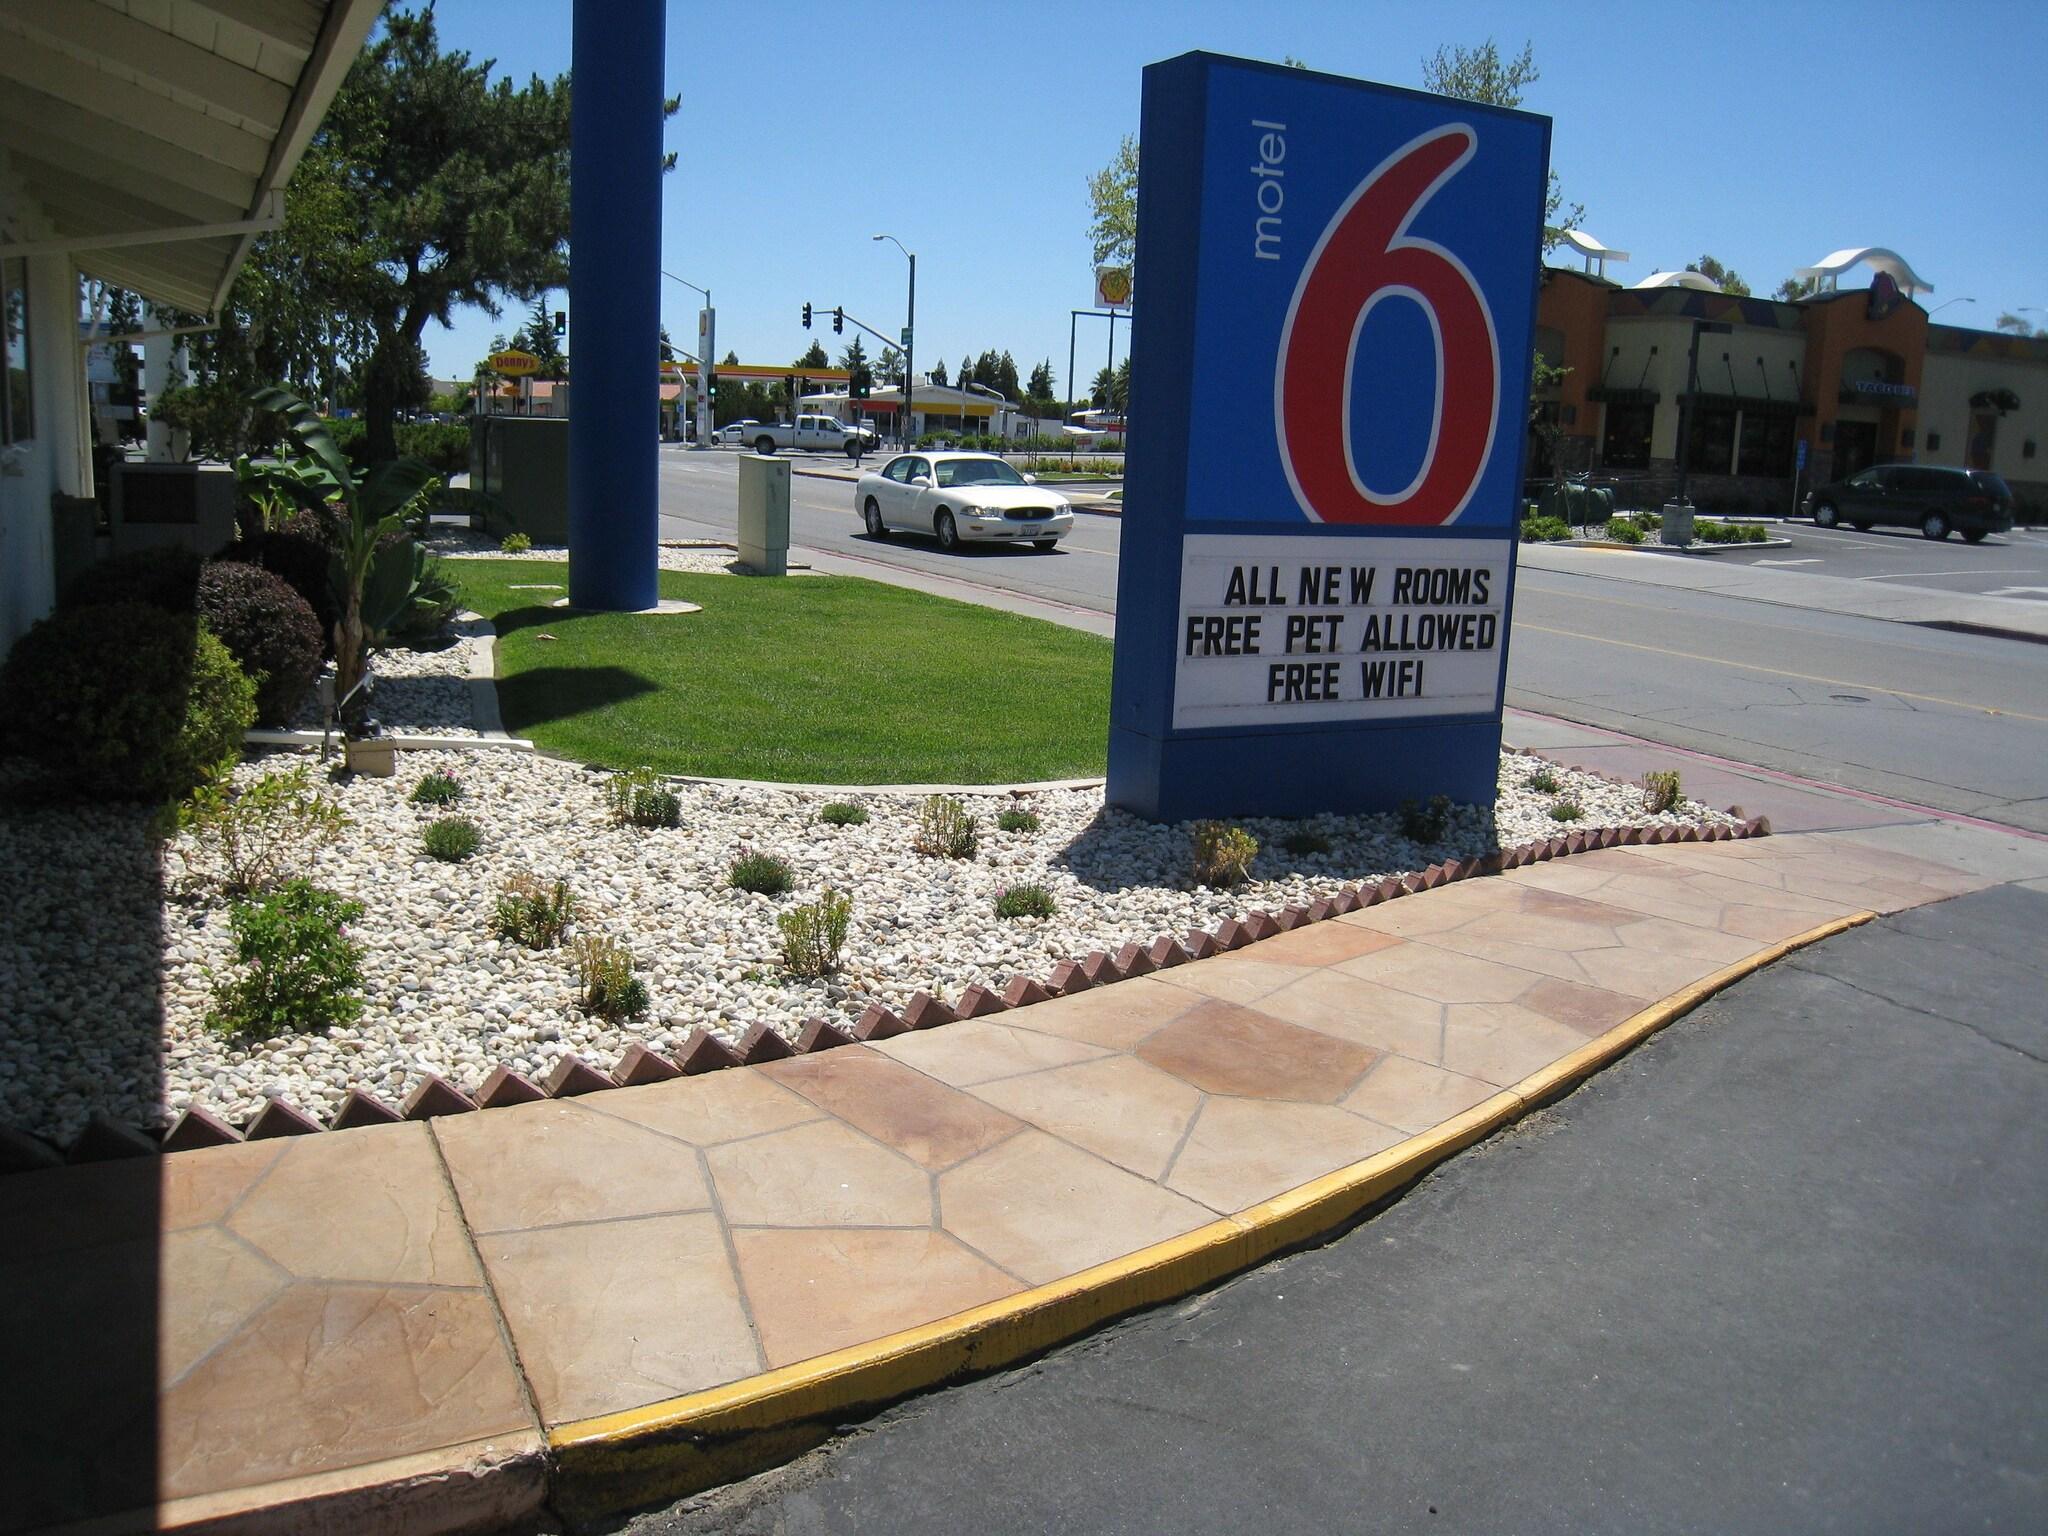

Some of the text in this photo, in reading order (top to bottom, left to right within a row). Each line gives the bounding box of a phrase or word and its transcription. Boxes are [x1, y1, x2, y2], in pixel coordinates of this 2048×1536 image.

[1251, 119, 1287, 260] motel
[1274, 122, 1501, 526] 6
[1224, 566, 1490, 605] ALL NEW ROOMS
[1186, 614, 1496, 656] FREE PET ALLOWED
[1267, 660, 1424, 702] FREE WIFI
